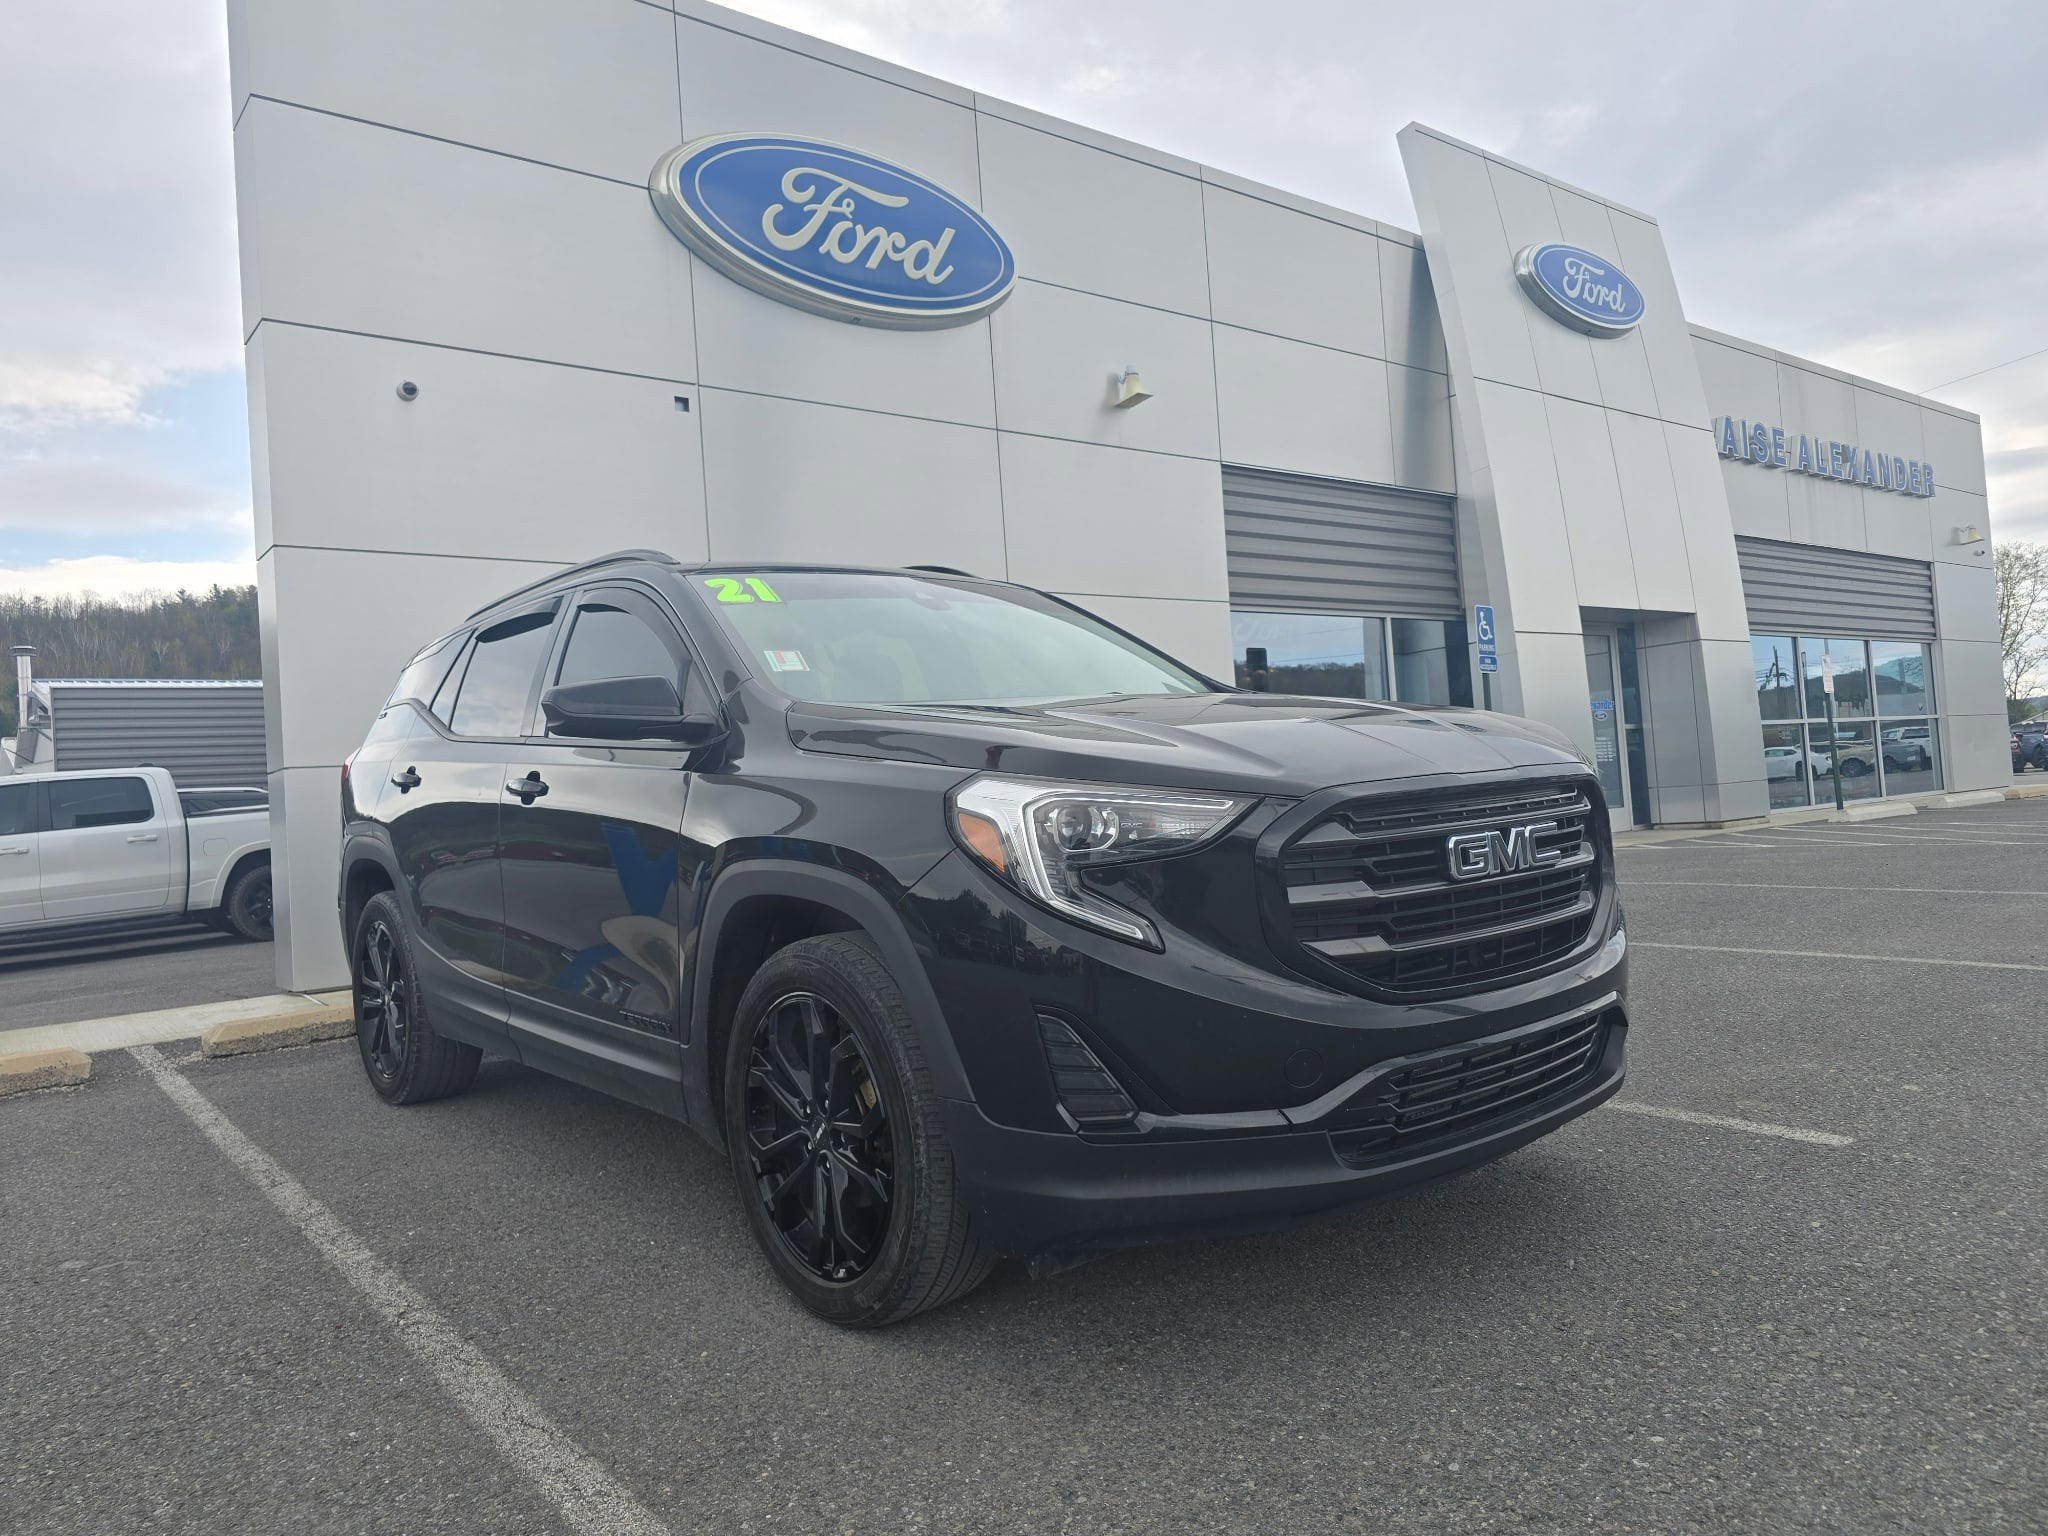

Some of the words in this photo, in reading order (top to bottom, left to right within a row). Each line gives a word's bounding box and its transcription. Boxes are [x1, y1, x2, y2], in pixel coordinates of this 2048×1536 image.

[762, 167, 955, 285] Ford
[1563, 257, 1625, 313] Ford
[1798, 433, 1936, 497] ALEXANDER
[704, 578, 782, 603] 21
[1449, 821, 1561, 880] GMC
